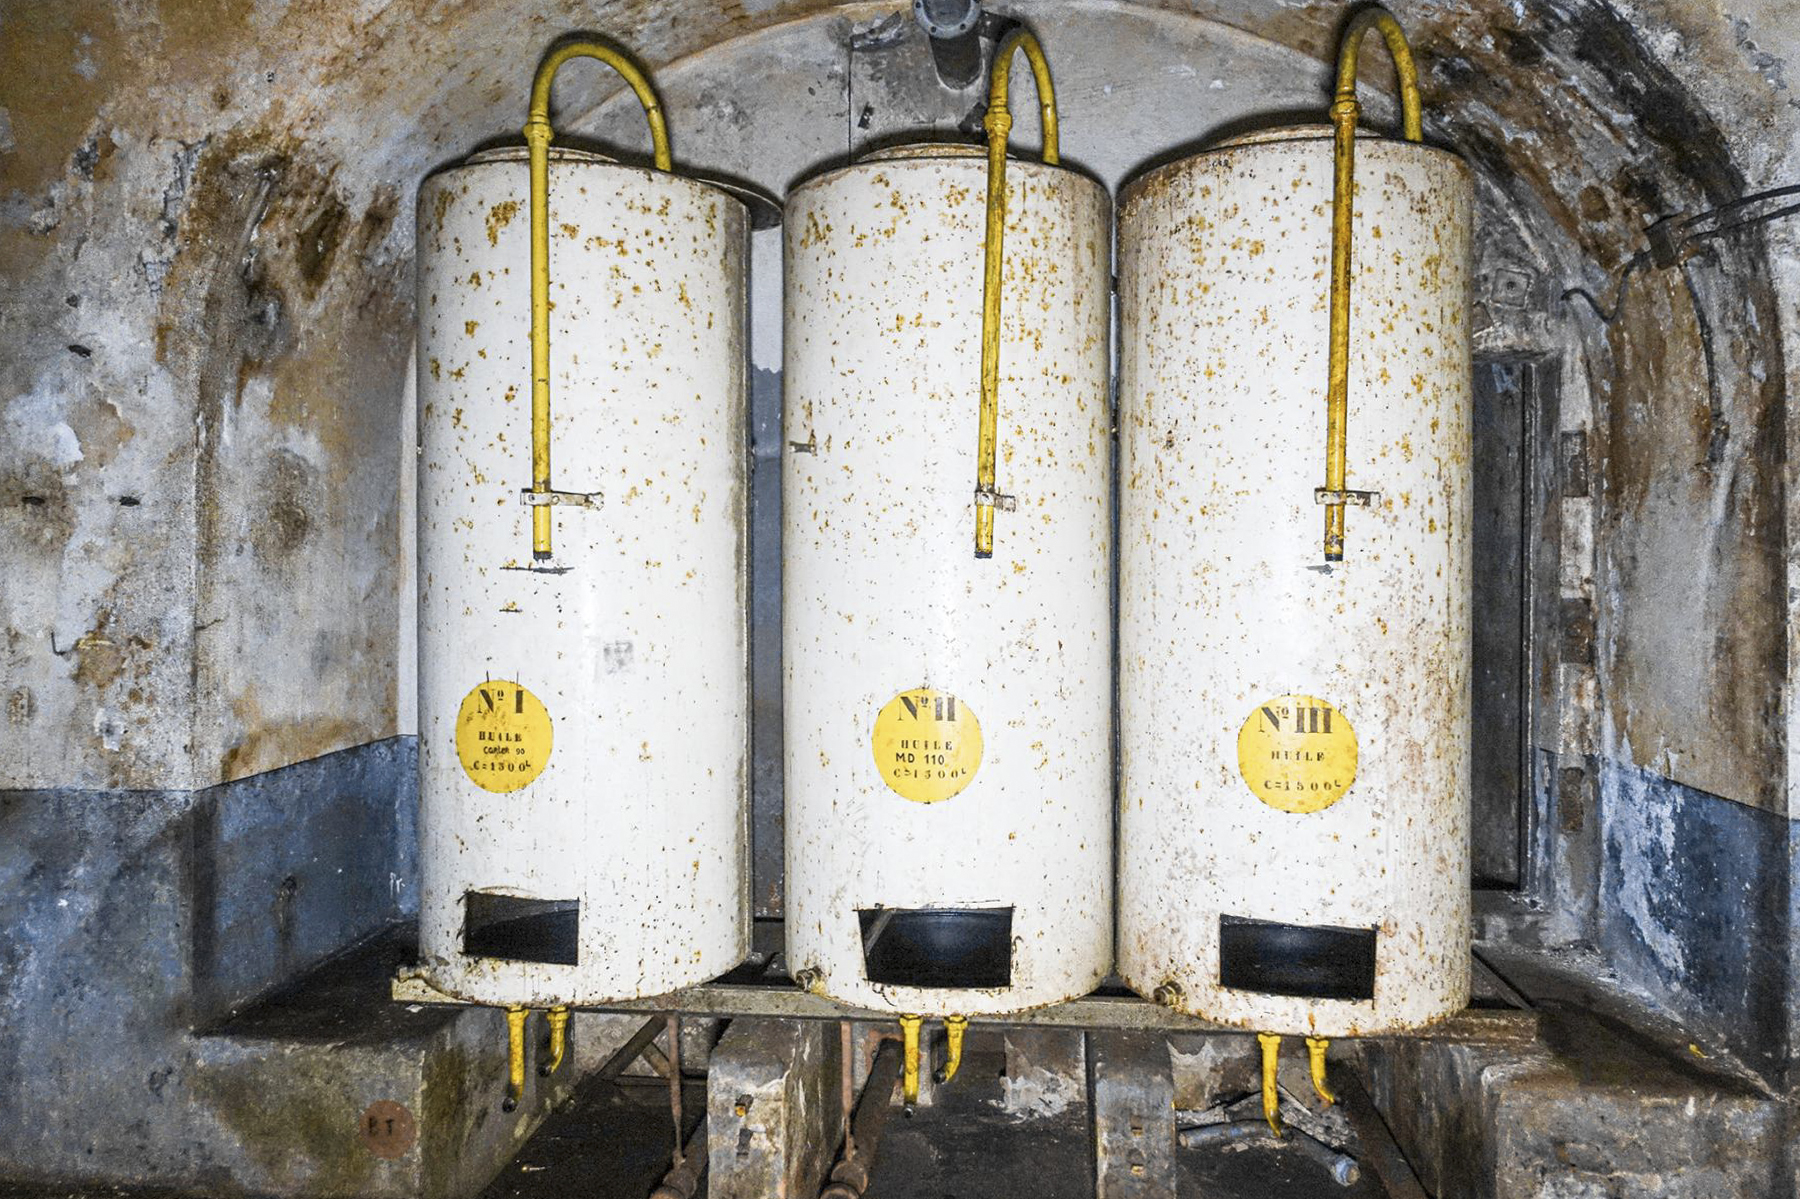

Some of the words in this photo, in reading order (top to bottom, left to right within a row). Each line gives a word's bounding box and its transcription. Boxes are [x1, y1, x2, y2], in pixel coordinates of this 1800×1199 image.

[935, 697, 957, 721] II
[1294, 706, 1333, 734] III
[478, 731, 522, 742] HUILE
[895, 752, 915, 764] MD
[924, 754, 945, 765] 110
